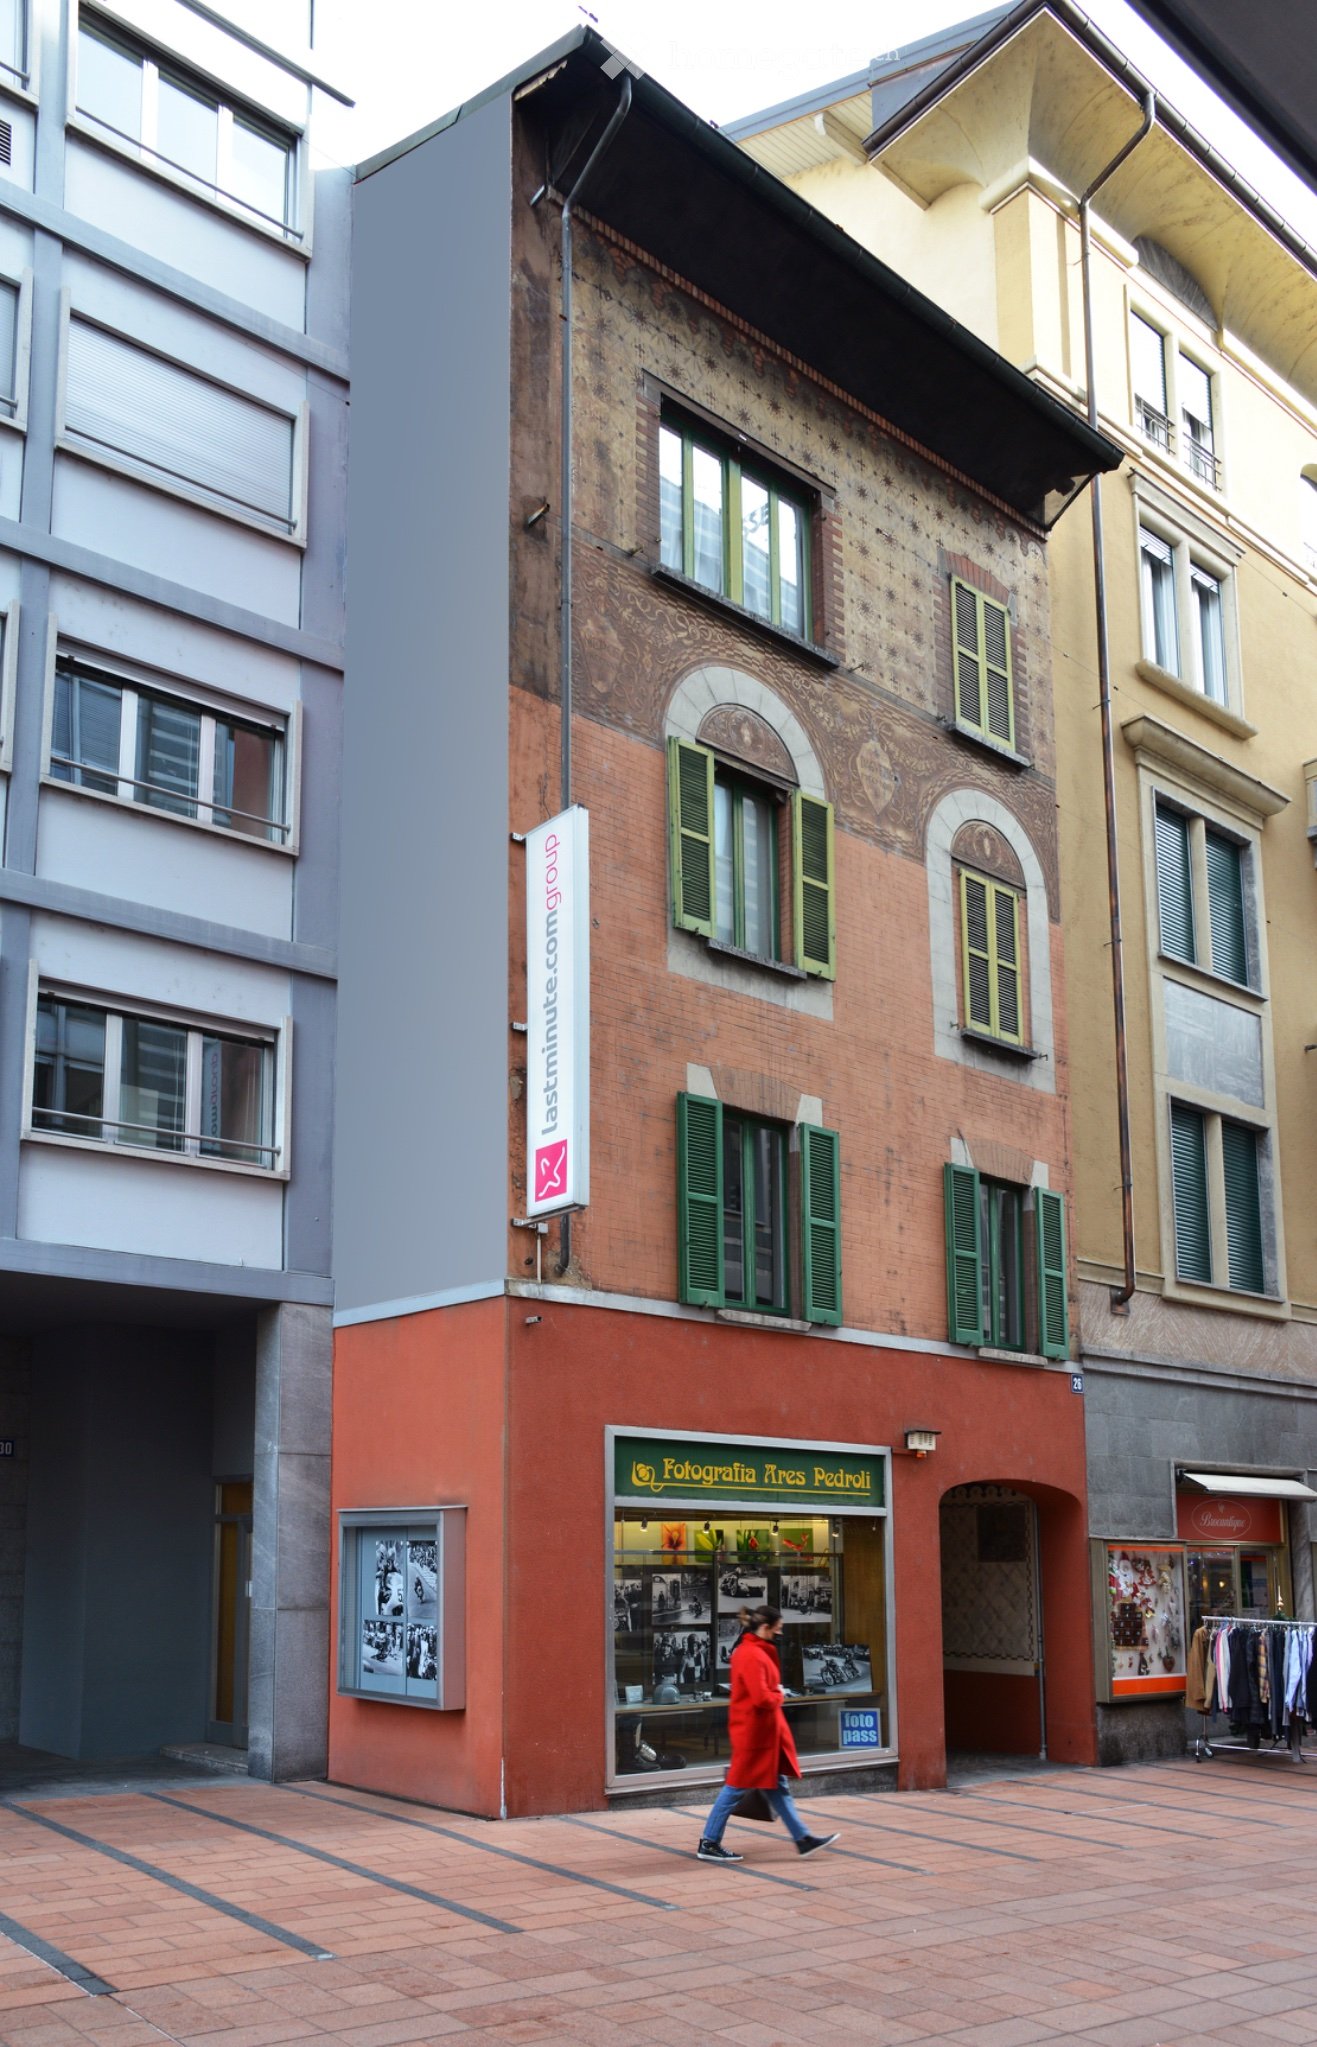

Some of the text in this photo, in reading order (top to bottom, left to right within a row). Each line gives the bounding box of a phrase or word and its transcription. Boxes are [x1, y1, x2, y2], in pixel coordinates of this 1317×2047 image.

[1073, 1377, 1082, 1390] 26
[663, 1458, 871, 1489] Fotografia Ares Pedroli
[845, 1712, 874, 1728] foto
[843, 1729, 878, 1745] pass
